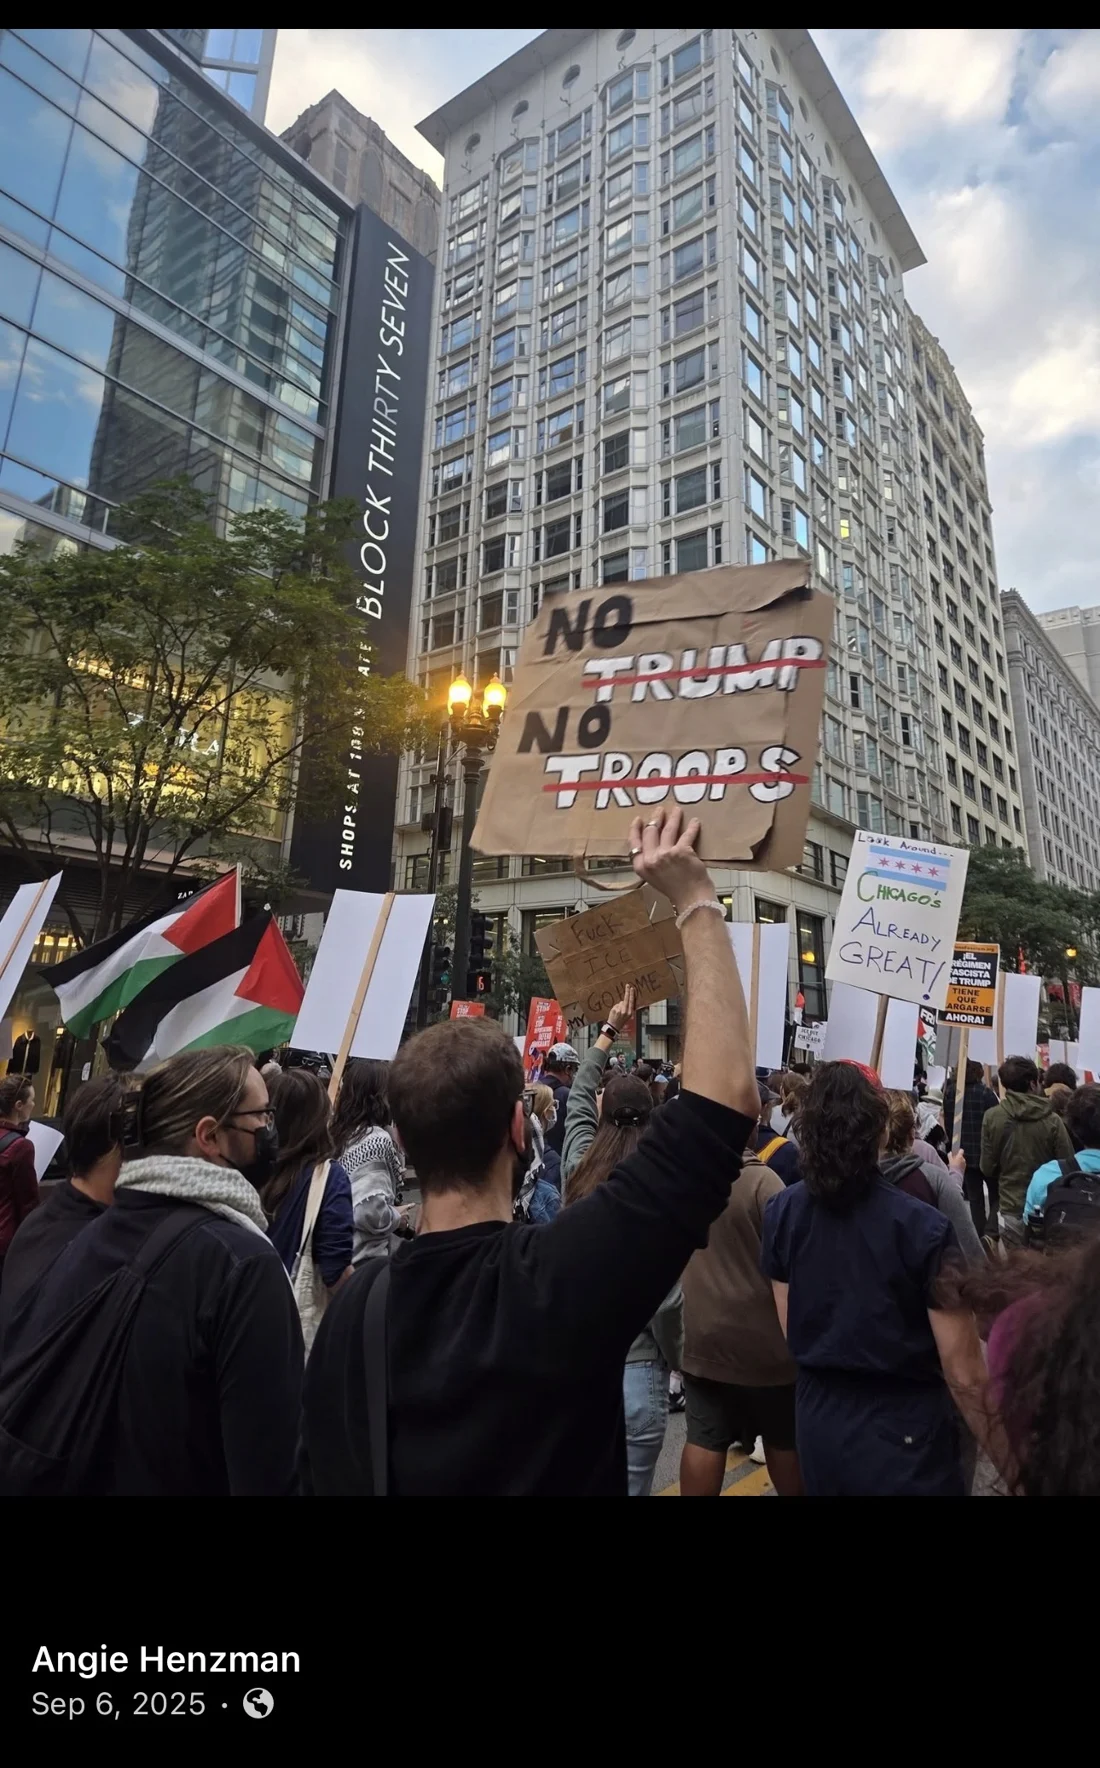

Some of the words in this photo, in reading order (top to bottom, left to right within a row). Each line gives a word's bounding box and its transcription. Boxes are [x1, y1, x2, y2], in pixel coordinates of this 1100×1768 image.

[379, 241, 410, 356] SEVEN
[367, 353, 401, 476] THIRTY
[355, 484, 391, 619] BLOCK
[544, 594, 633, 655] NO
[582, 635, 825, 703] TRUMP
[516, 704, 613, 754] NO
[346, 769, 360, 795] AT
[543, 745, 801, 810] TROOPS
[339, 804, 357, 870] SHOPS
[858, 833, 889, 847] Look
[584, 947, 634, 980] ICE
[839, 941, 946, 1001] GREAT!
[478, 976, 485, 991] 6
[952, 987, 980, 996] TIENE
[959, 977, 991, 987] TRUMP
[586, 990, 615, 1013] GO
[946, 1004, 991, 1013] ARGARSE
[957, 995, 977, 1004] QUE
[945, 1013, 984, 1024] AHORA!
